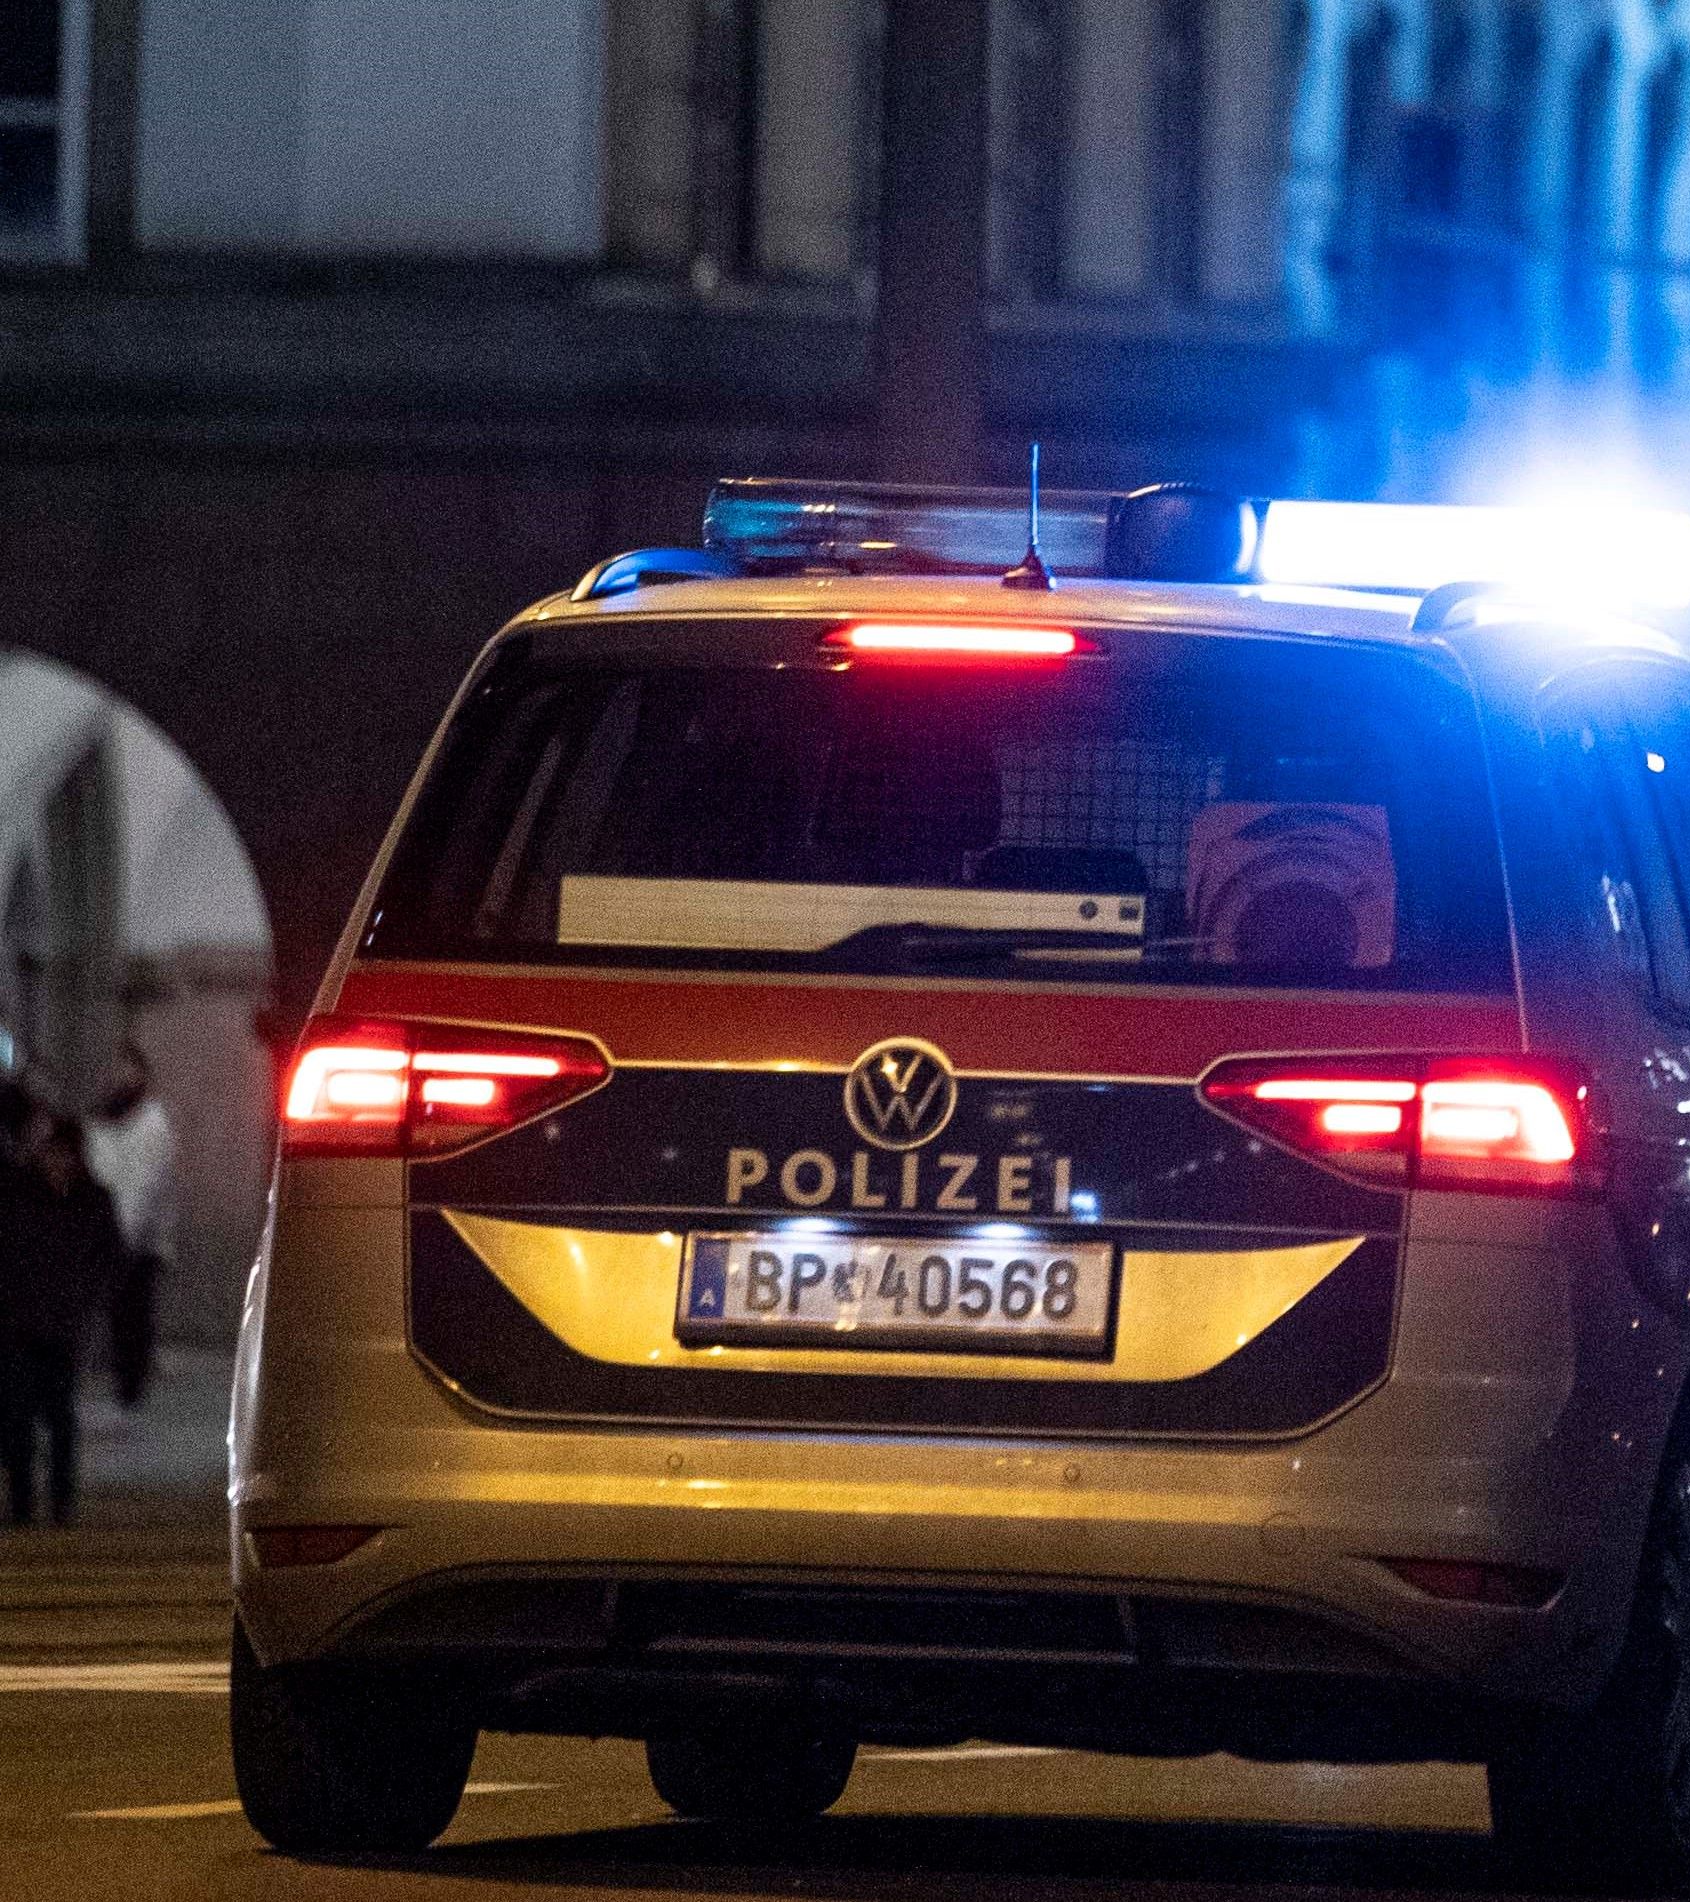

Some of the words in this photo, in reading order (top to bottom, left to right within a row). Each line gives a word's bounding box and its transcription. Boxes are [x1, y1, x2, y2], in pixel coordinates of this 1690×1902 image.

[853, 1045, 951, 1139] VW
[725, 1147, 1072, 1213] POLIZEI
[697, 1287, 716, 1308] A
[745, 1250, 827, 1314] BP
[876, 1252, 1079, 1321] 40568
